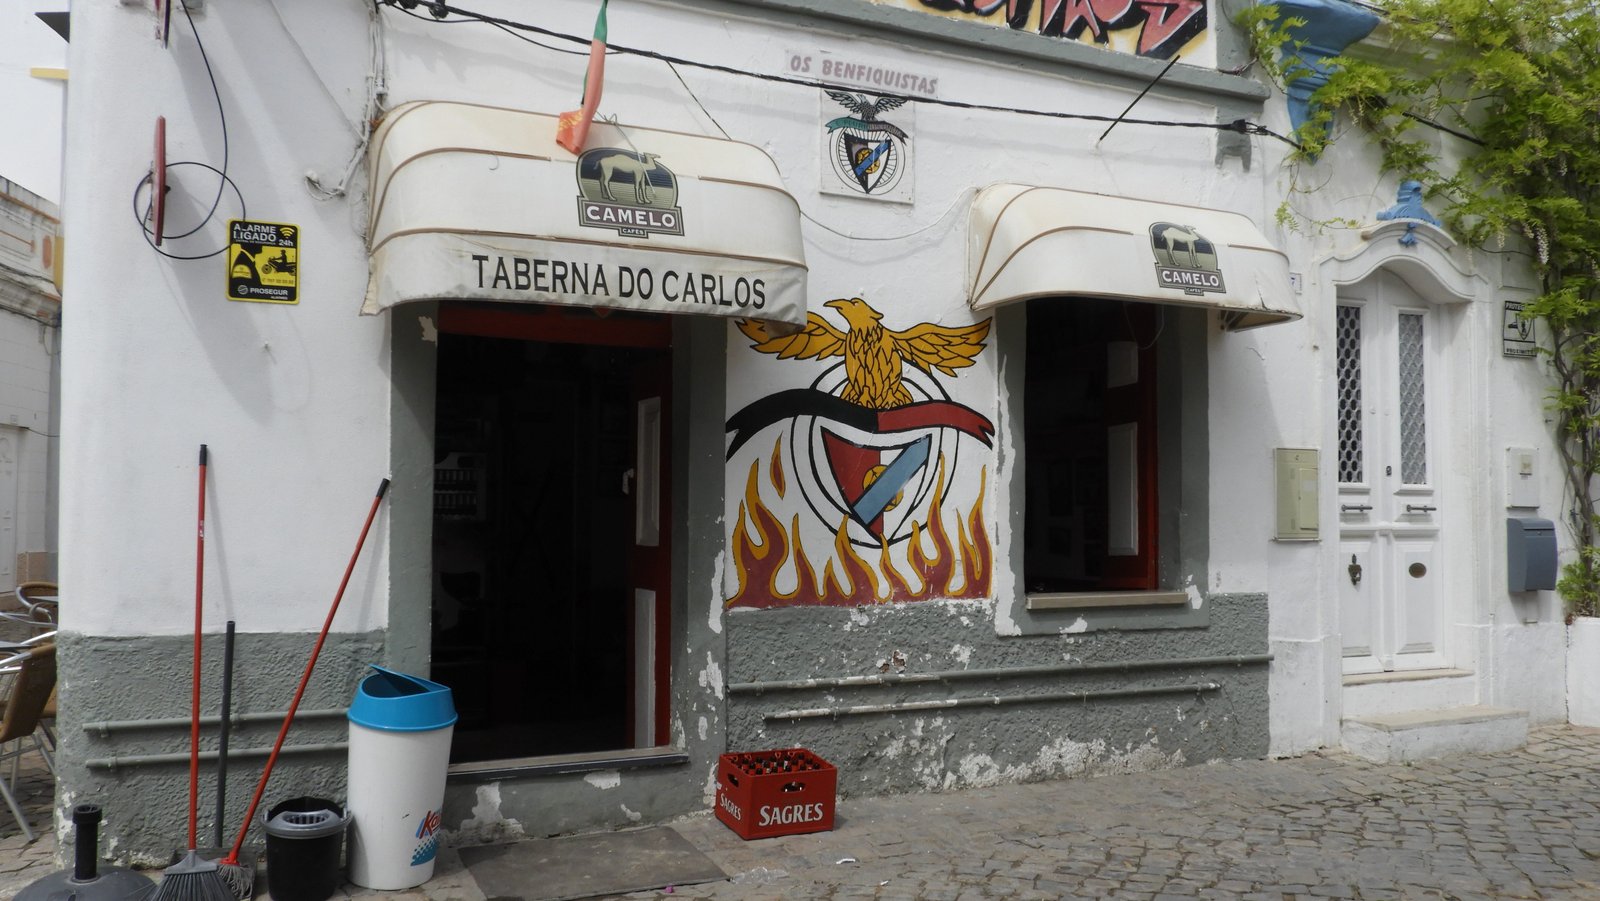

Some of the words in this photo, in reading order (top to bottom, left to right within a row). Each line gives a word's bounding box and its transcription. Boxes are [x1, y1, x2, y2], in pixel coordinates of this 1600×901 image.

[790, 55, 812, 73] OS
[822, 59, 938, 95] BENFIQUISTAS
[586, 205, 675, 227] CAMELO
[233, 231, 277, 242] LIGADO
[278, 239, 294, 247] 24h
[472, 254, 609, 296] TABERNA
[618, 266, 654, 300] DO
[661, 270, 767, 310] CARLOS
[1162, 270, 1219, 287] CAMELO
[720, 792, 742, 821] SAGRES
[758, 802, 824, 827] SAGRES
